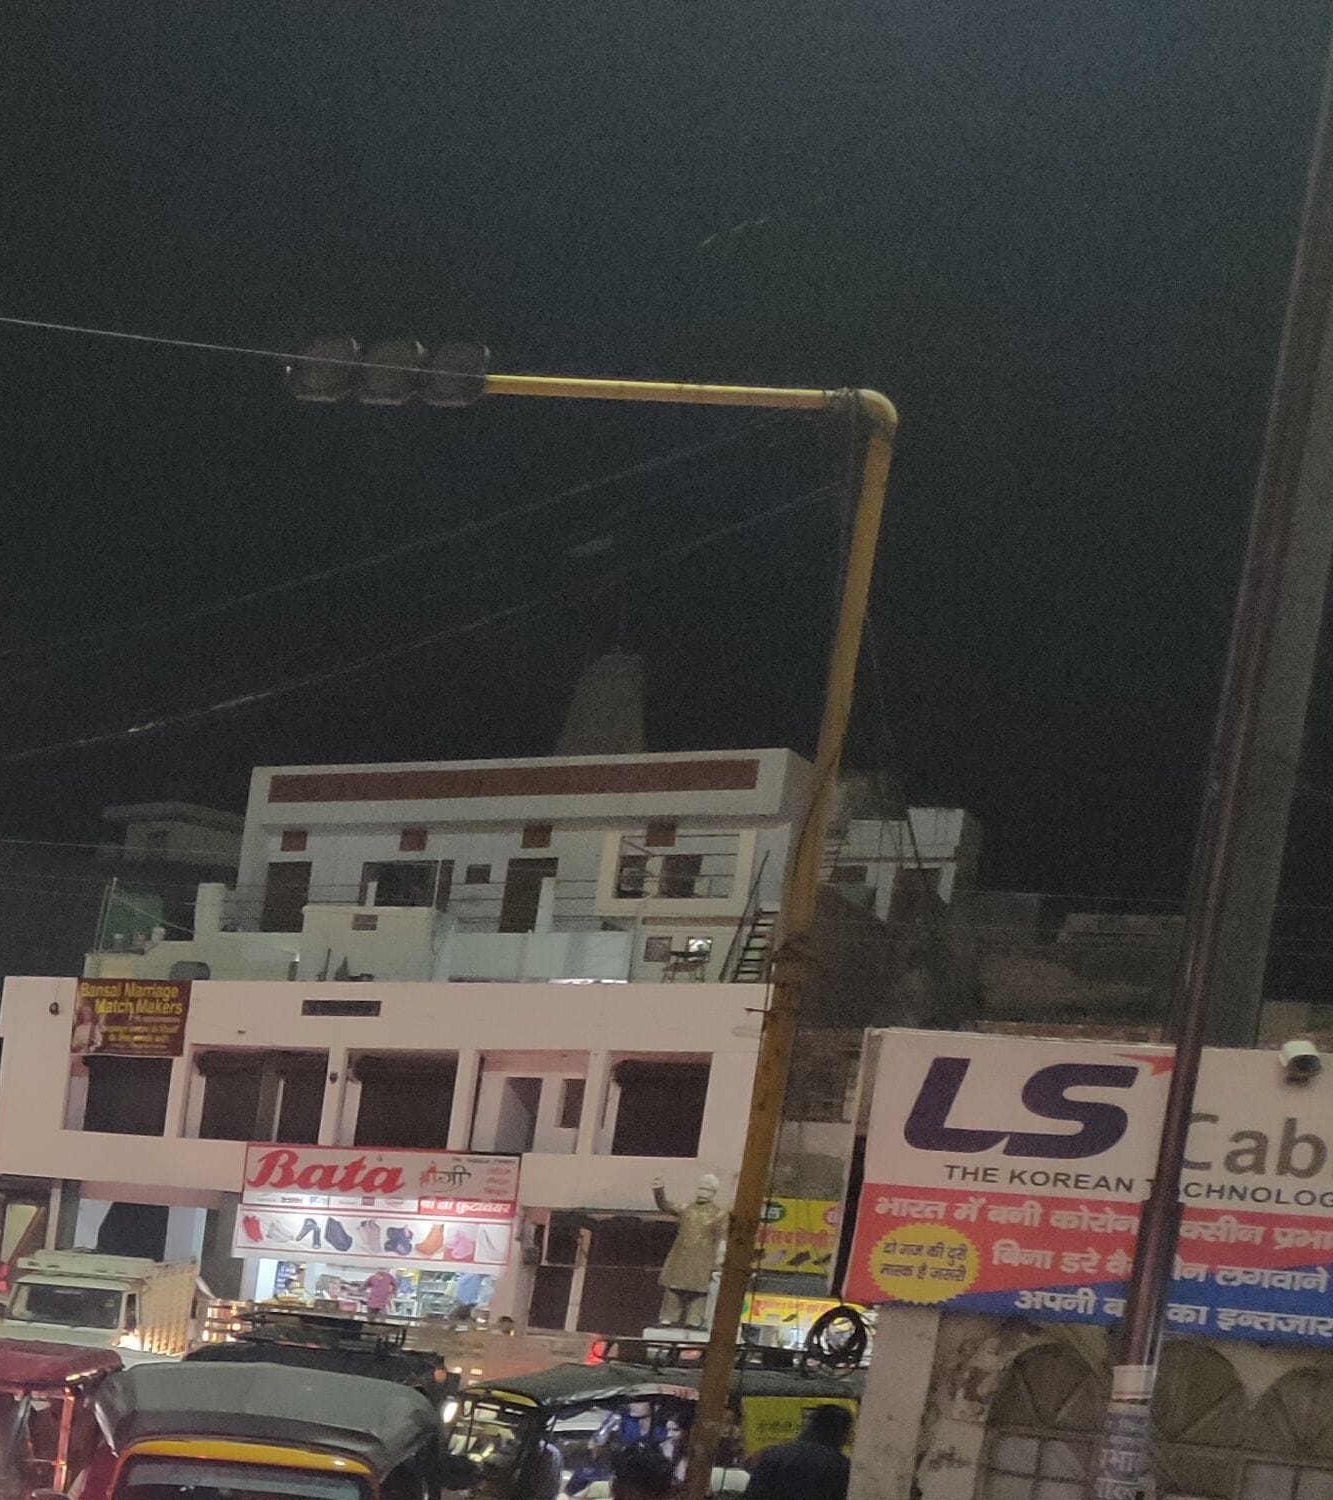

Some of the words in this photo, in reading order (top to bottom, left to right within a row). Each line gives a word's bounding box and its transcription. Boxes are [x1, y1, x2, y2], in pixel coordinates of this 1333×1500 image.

[903, 1057, 1139, 1159] LS
[247, 1149, 405, 1194] Bata
[944, 1164, 999, 1183] THE
[1009, 1169, 1133, 1193] KOREAN
[1146, 1179, 1333, 1208] TCHNOLOG
[875, 1196, 948, 1220] भारत
[954, 1196, 986, 1223] में
[988, 1200, 1043, 1228] बनी
[1050, 1205, 1138, 1233] कोरोन
[992, 1239, 1054, 1270] बिना
[1061, 1247, 1101, 1274] डरे
[1216, 1265, 1328, 1293] लगवाने
[1014, 1287, 1098, 1315] अपनी
[1168, 1303, 1209, 1325] का
